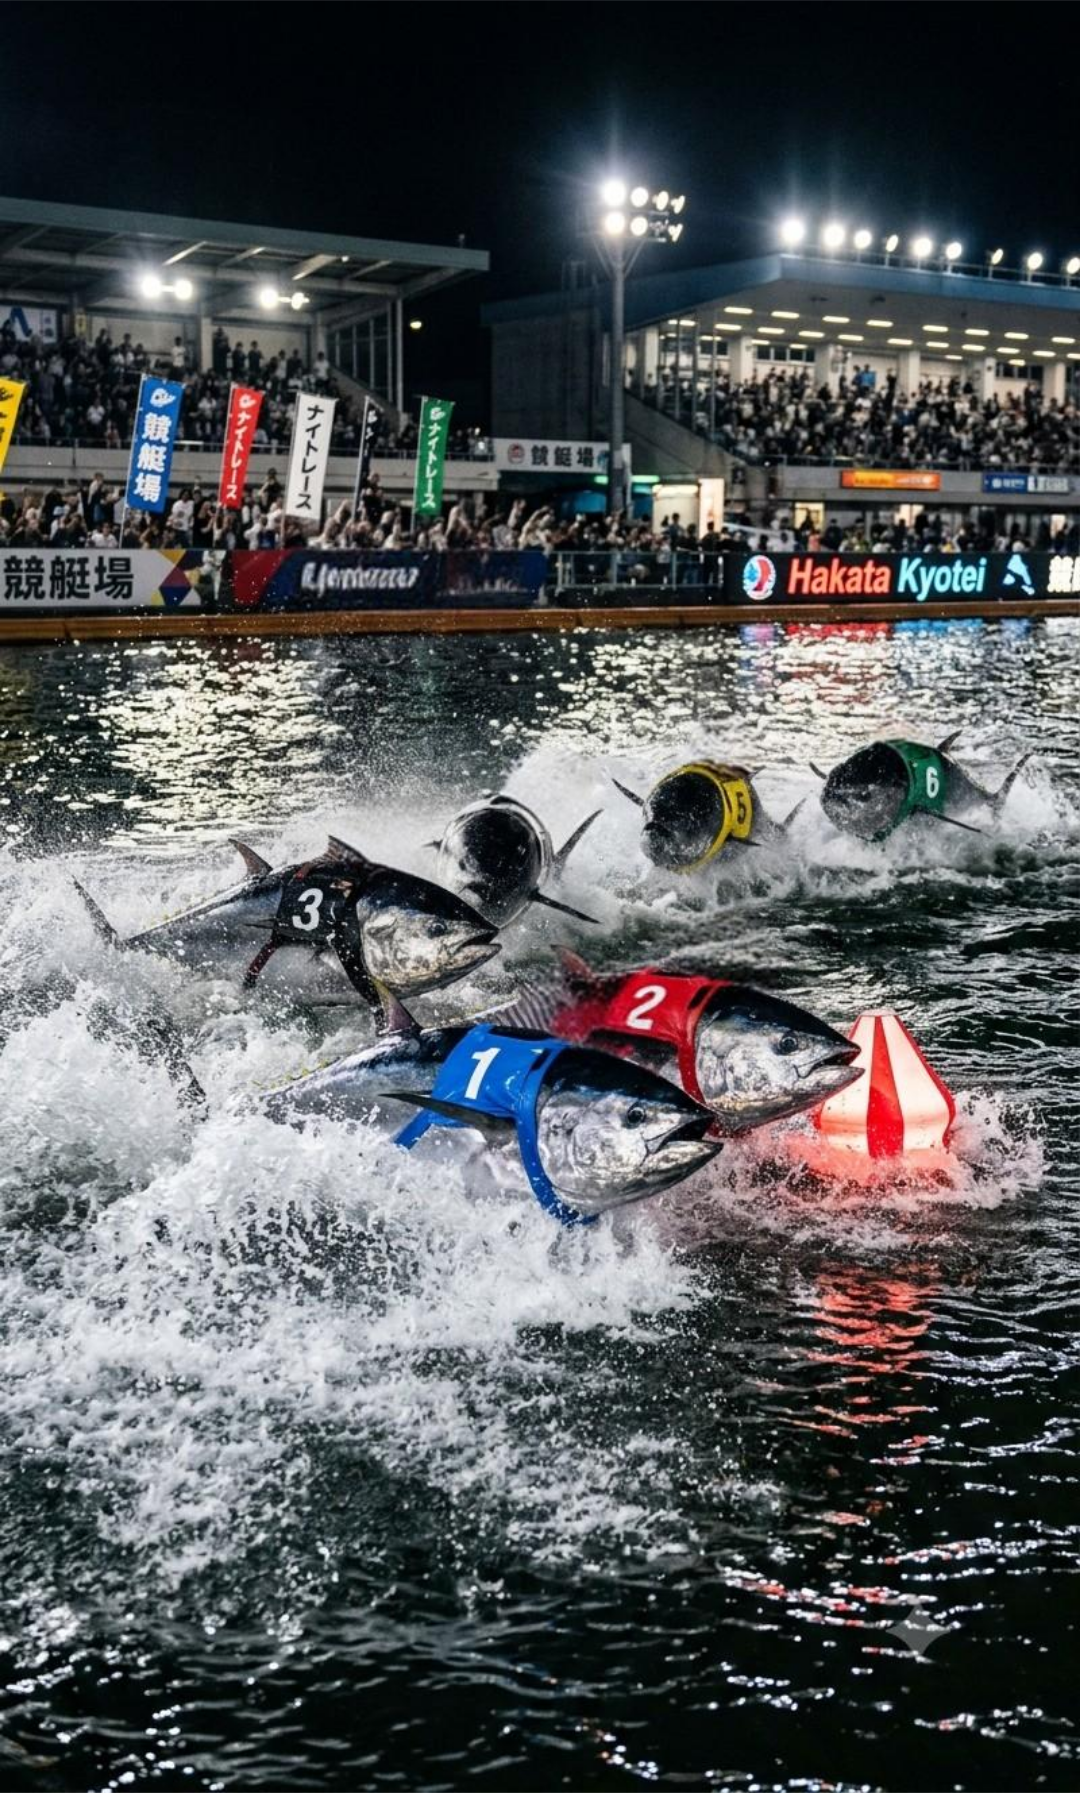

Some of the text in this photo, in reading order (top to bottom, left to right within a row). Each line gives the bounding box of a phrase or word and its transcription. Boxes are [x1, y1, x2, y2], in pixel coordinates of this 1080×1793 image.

[133, 412, 172, 503] 競艇場
[226, 412, 251, 499] ナイトレース
[295, 405, 325, 510] ナイトレース
[421, 423, 441, 508] ナイトレース
[4, 555, 134, 600] 競艇場
[788, 557, 987, 601] Hakata Kyotei
[926, 767, 940, 799] 6
[735, 791, 747, 825] 5
[292, 888, 324, 931] 3
[626, 985, 667, 1030] 2
[464, 1047, 501, 1100] 1
